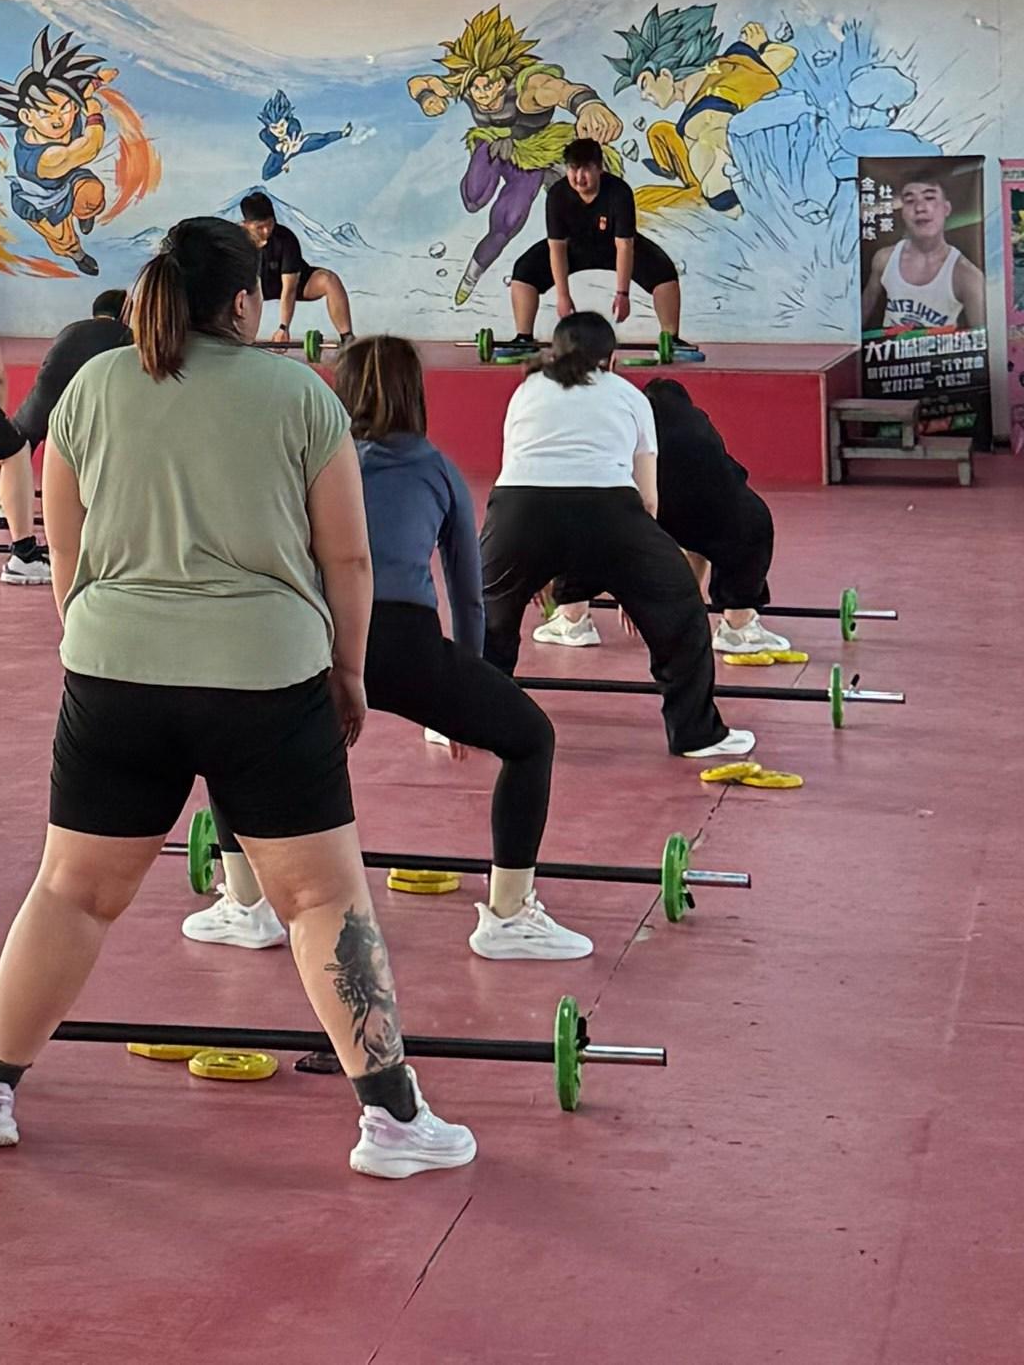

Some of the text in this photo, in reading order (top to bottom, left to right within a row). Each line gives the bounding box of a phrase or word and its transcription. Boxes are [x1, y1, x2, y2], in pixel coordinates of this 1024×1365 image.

[864, 328, 987, 364] 大力减肥训练营
